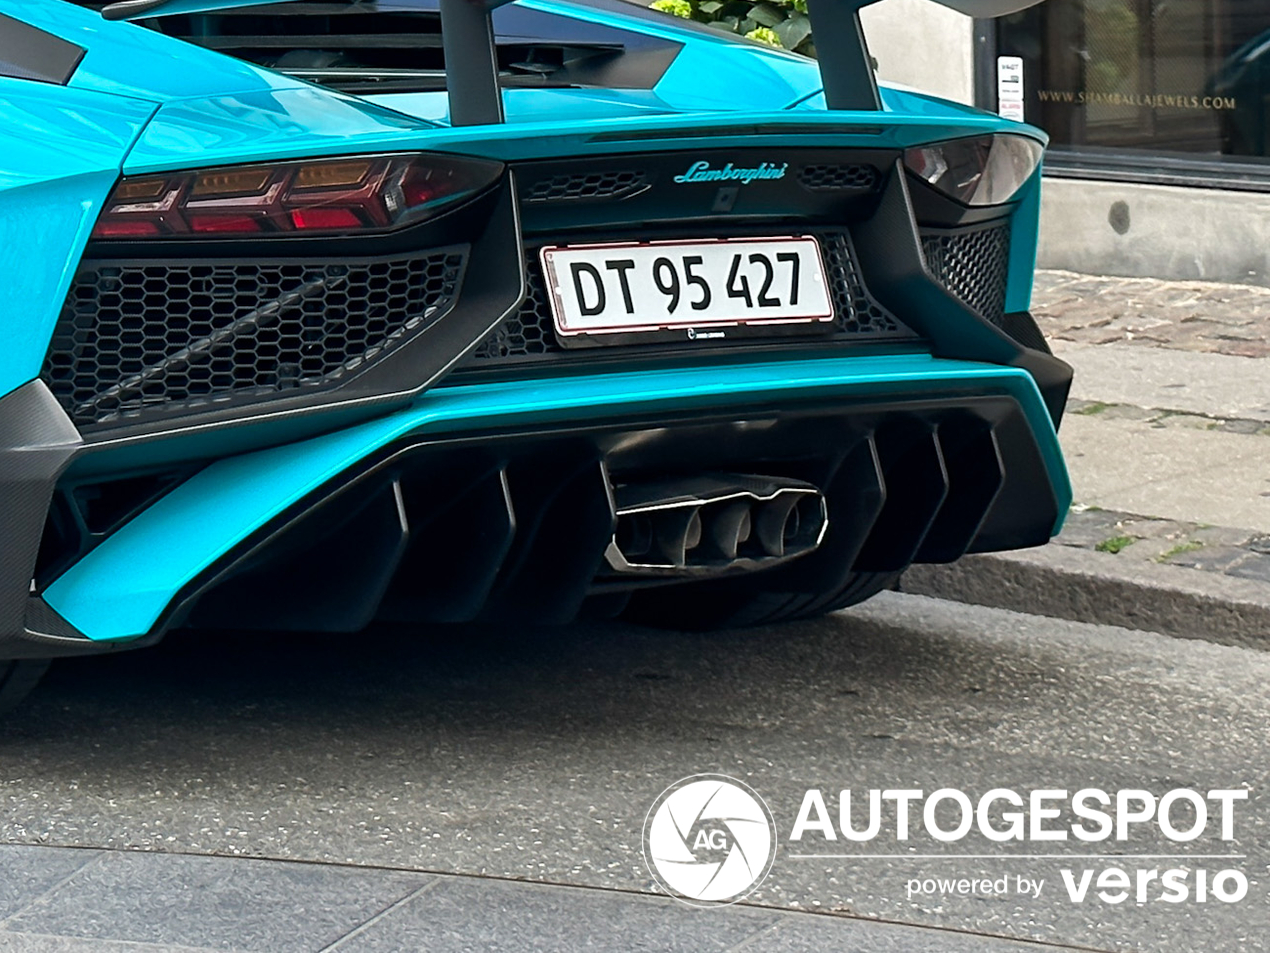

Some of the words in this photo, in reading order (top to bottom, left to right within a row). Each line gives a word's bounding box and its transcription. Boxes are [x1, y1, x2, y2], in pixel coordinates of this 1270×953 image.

[1037, 90, 1236, 109] WWW.SHAMBALLAJEWELS.COM
[674, 161, 788, 184] Lamborghini
[570, 259, 635, 316] DT
[652, 256, 712, 315] 95
[726, 252, 800, 308] 427
